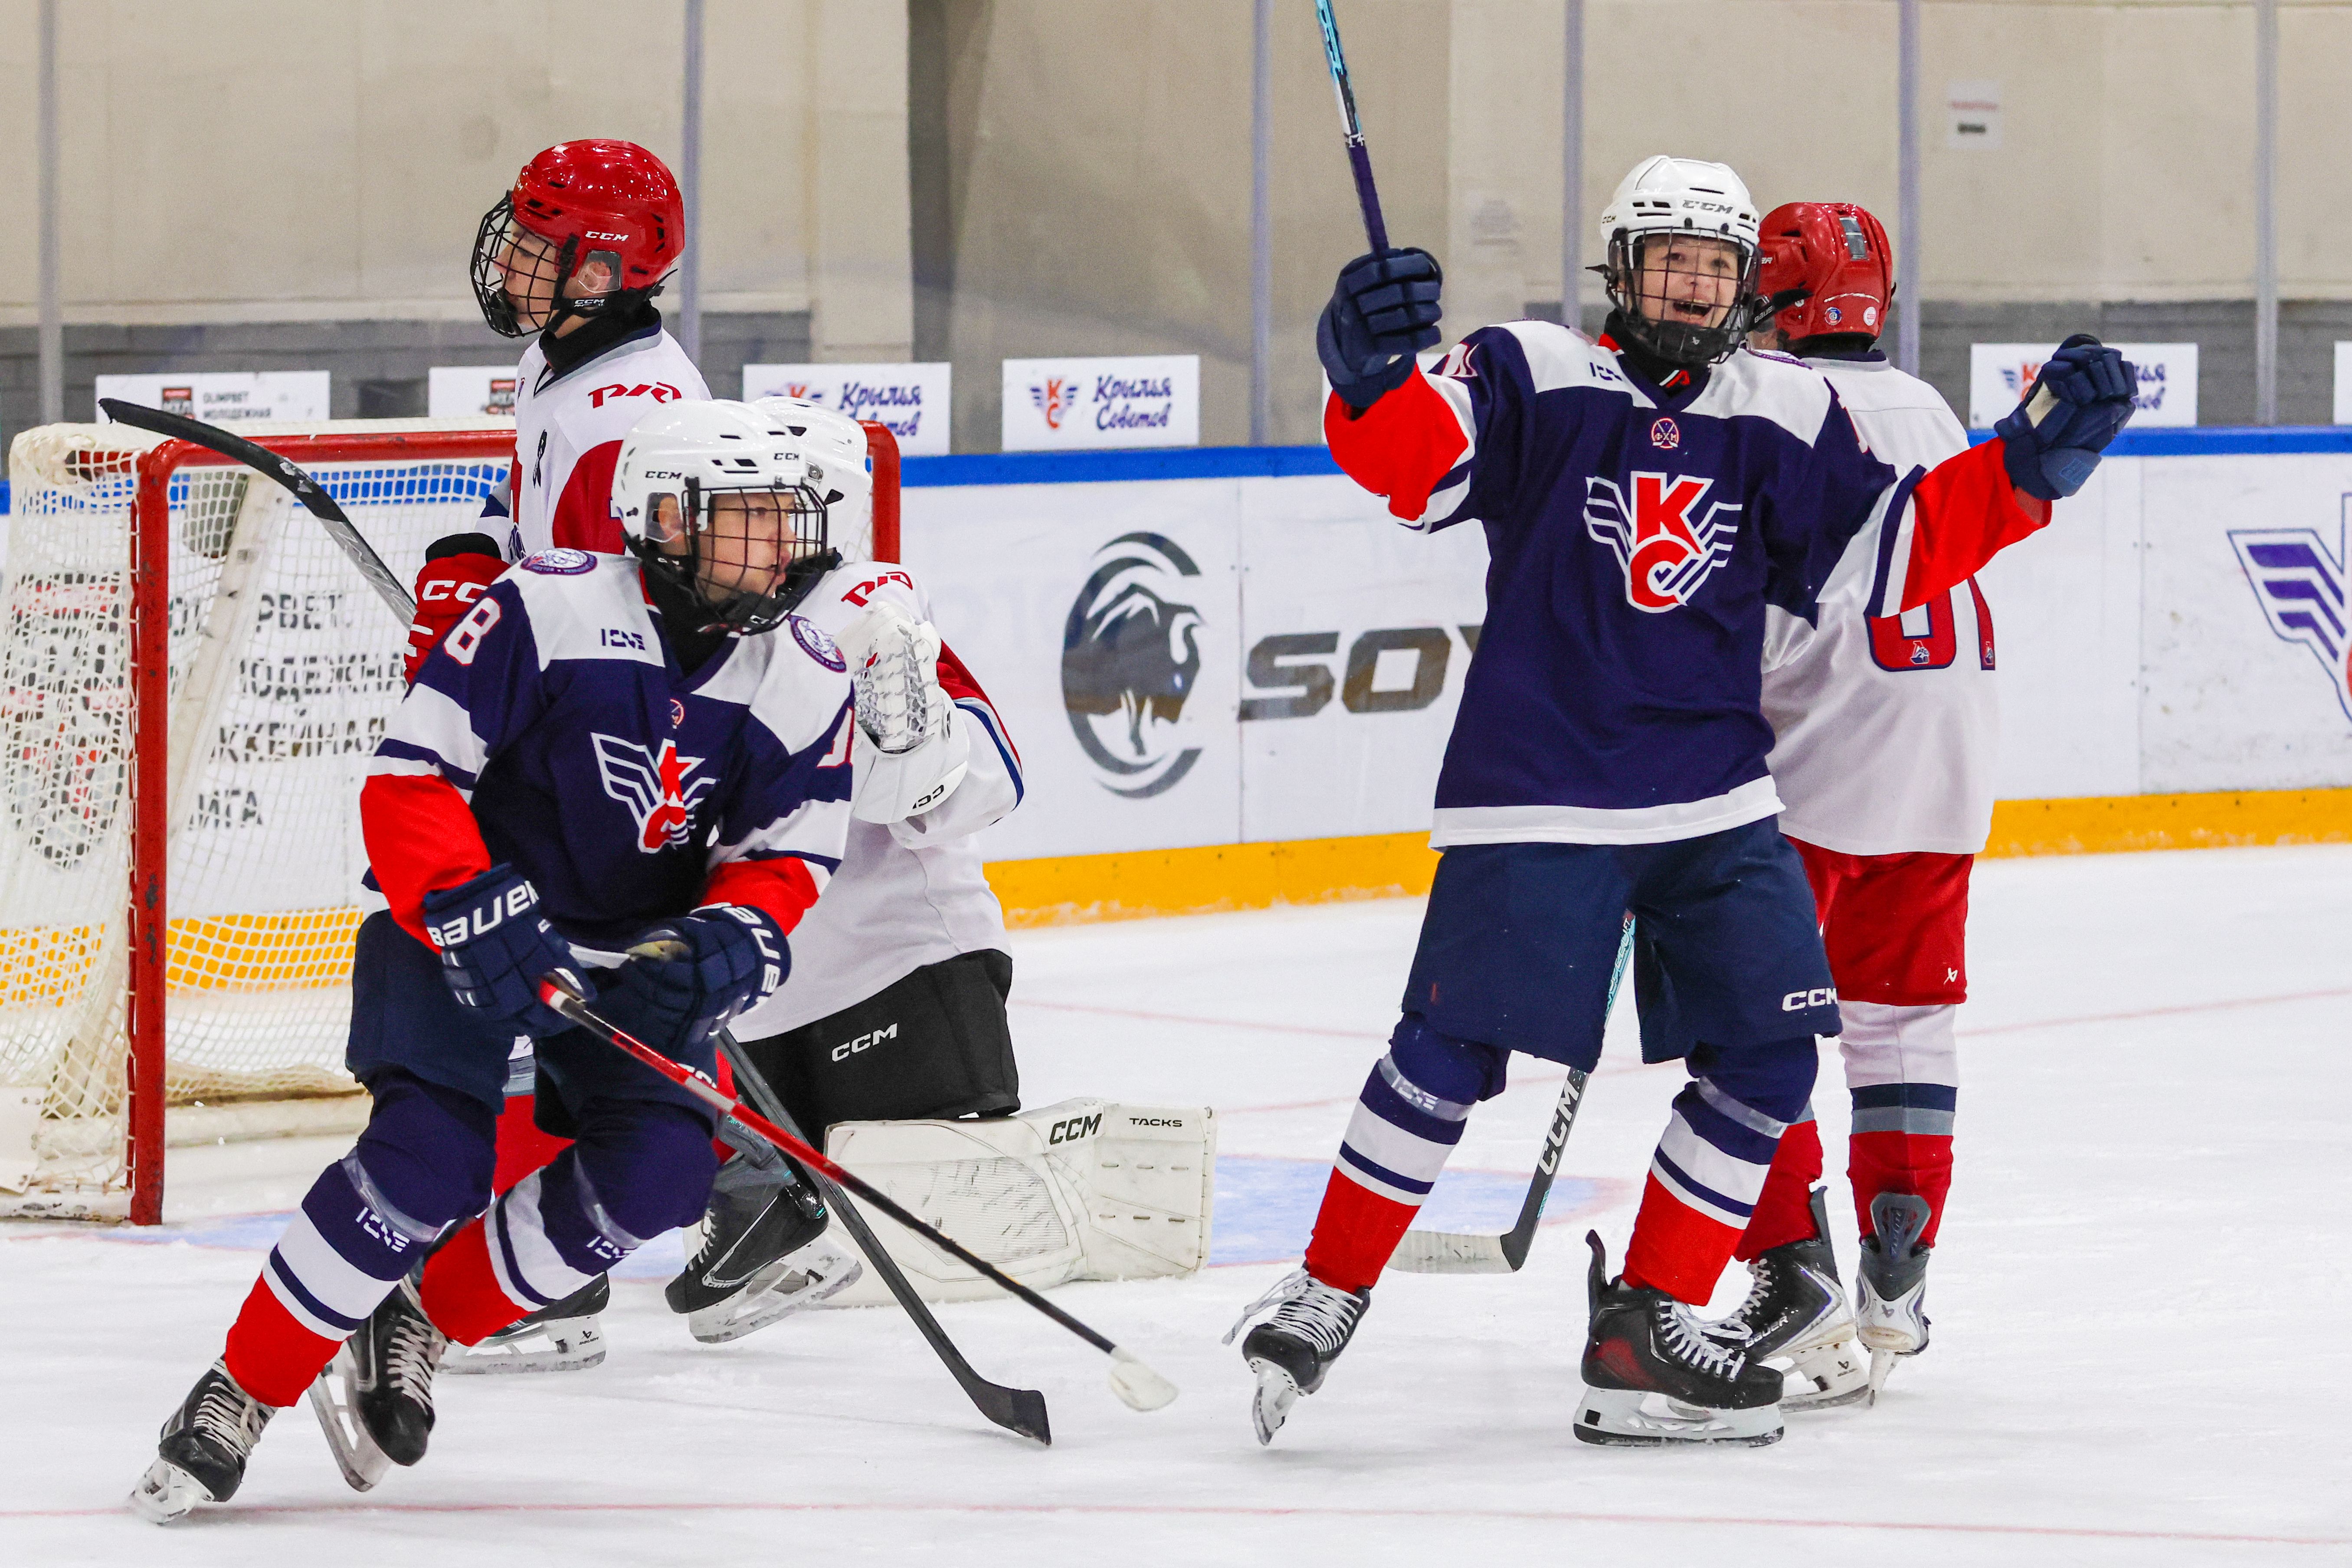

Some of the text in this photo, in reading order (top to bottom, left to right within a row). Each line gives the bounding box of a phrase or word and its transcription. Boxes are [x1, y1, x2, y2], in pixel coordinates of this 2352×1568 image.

[1682, 200, 1733, 214] CCM
[585, 231, 629, 242] CCM
[645, 471, 682, 480] CCM
[421, 580, 489, 603] CC
[443, 596, 502, 666] 8
[1782, 988, 1838, 1012] CCM
[832, 1023, 898, 1062] CCM
[1049, 1113, 1102, 1145] CCM
[1129, 1117, 1183, 1127] TACKS
[1538, 1079, 1580, 1176] CCM
